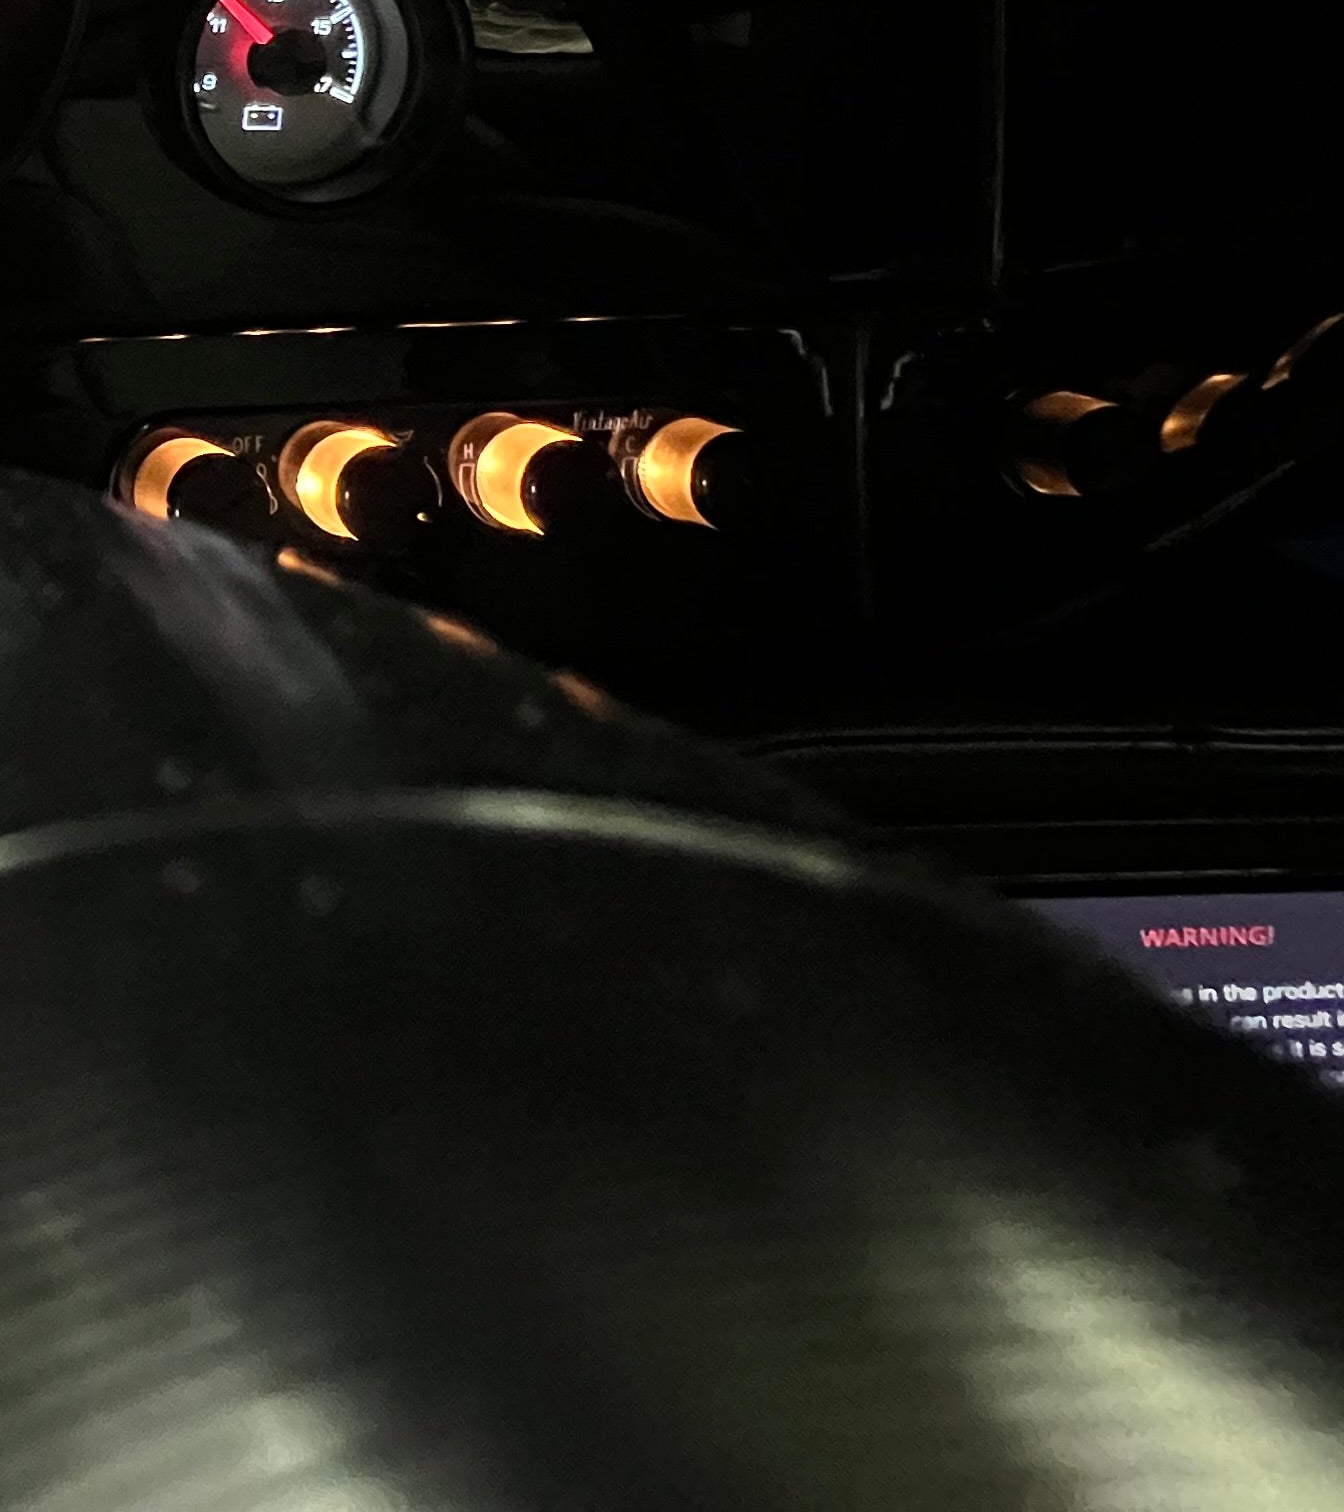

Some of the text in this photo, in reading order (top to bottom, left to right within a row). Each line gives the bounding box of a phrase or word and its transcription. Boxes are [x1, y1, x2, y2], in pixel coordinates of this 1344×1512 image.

[211, 16, 226, 33] 11
[312, 20, 332, 35] 15
[202, 74, 217, 90] 9
[232, 435, 263, 454] OFF
[464, 443, 474, 458] H
[1140, 925, 1275, 947] WARNING!
[1198, 985, 1218, 1002] in
[1223, 984, 1257, 1002] the
[1273, 1011, 1332, 1029] result
[1309, 1039, 1327, 1057] is
